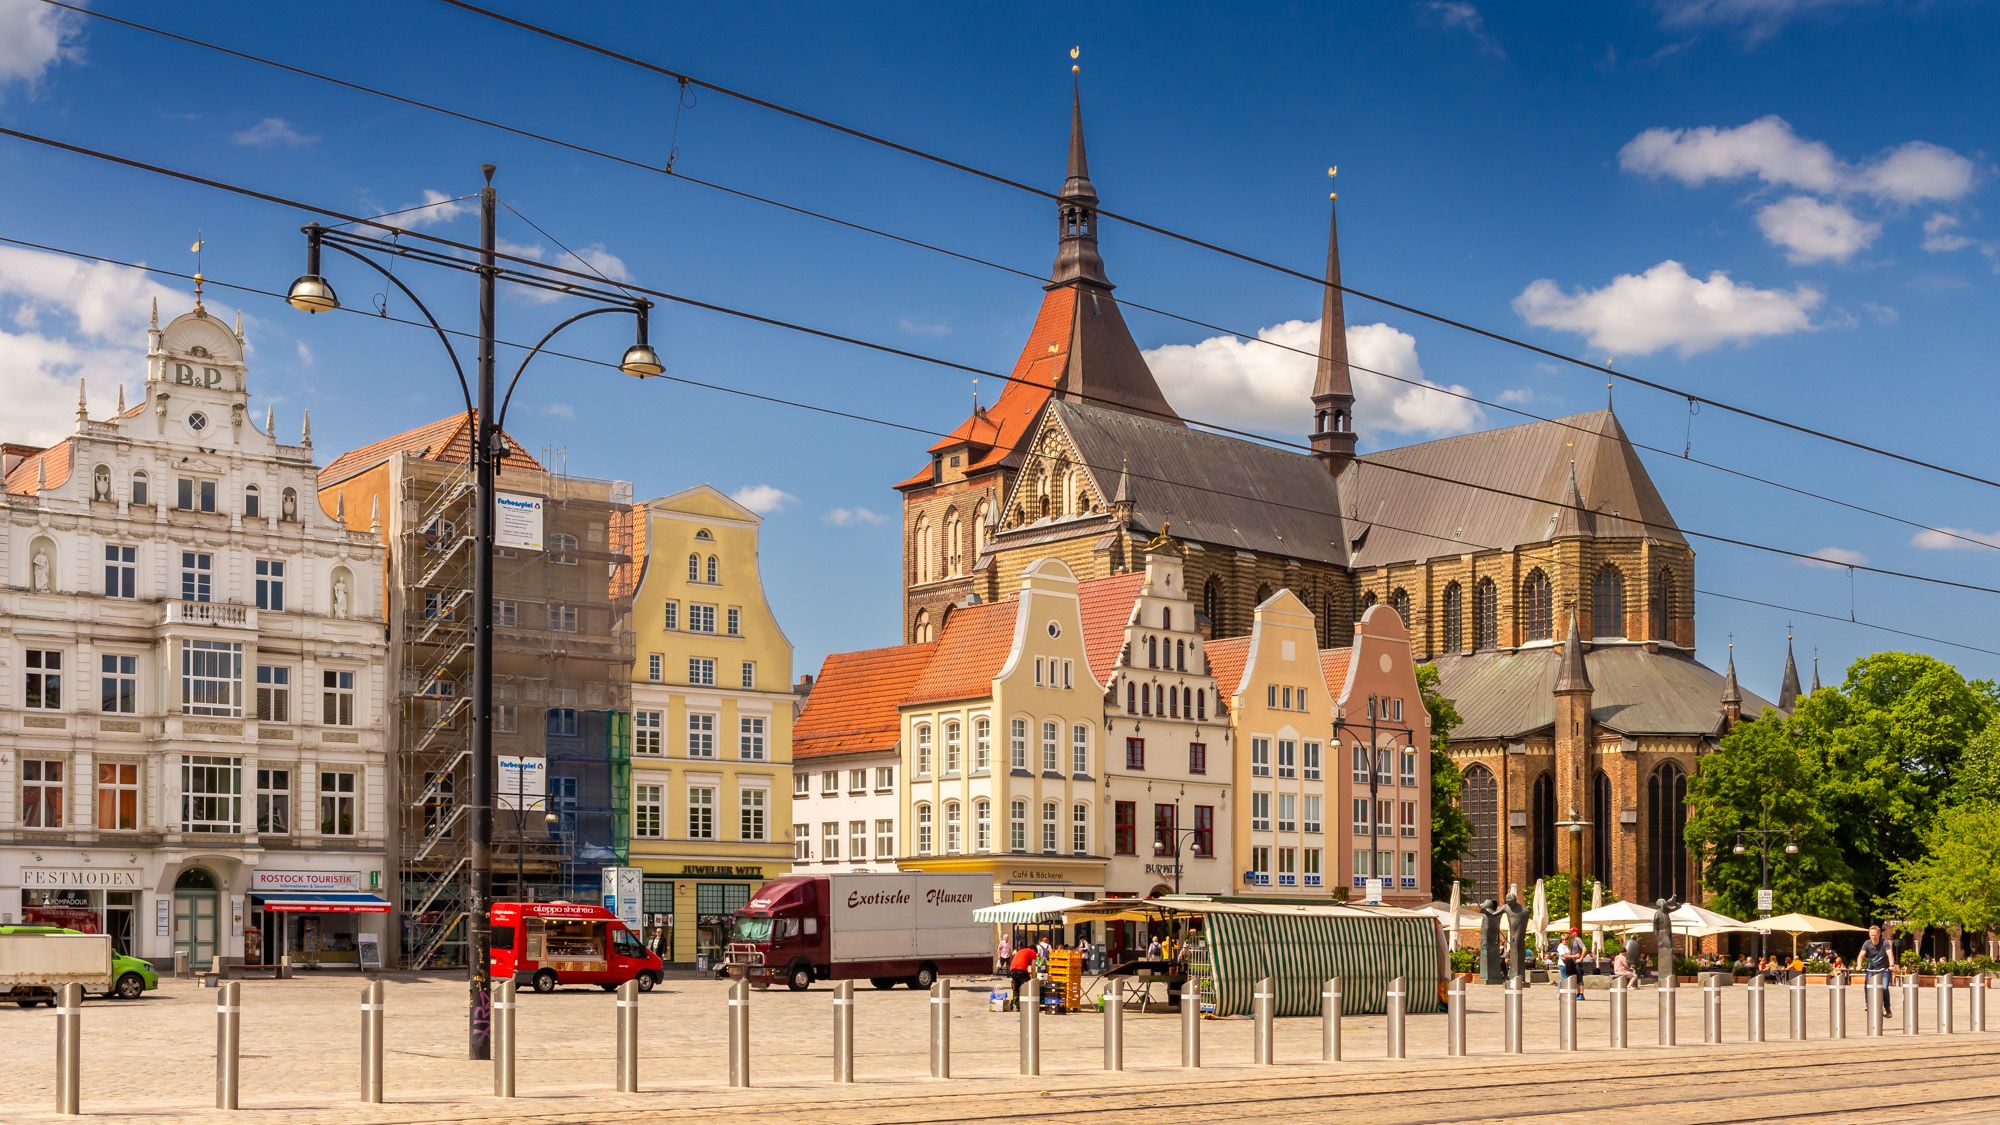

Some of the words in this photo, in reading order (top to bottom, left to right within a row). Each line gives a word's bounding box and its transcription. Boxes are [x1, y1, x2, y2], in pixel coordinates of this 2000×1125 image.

[681, 865, 734, 874] JUWELIER
[735, 866, 763, 875] WITT
[1012, 870, 1028, 879] Café
[1029, 870, 1034, 879] &
[1036, 871, 1064, 880] Bäckerei
[23, 871, 136, 886] FESTMODEN
[260, 874, 304, 884] ROSTOCK
[307, 875, 353, 884] TOURISTIK
[847, 889, 911, 909] Exotische
[926, 888, 973, 907] Pflanzen
[533, 905, 563, 914] aleppo
